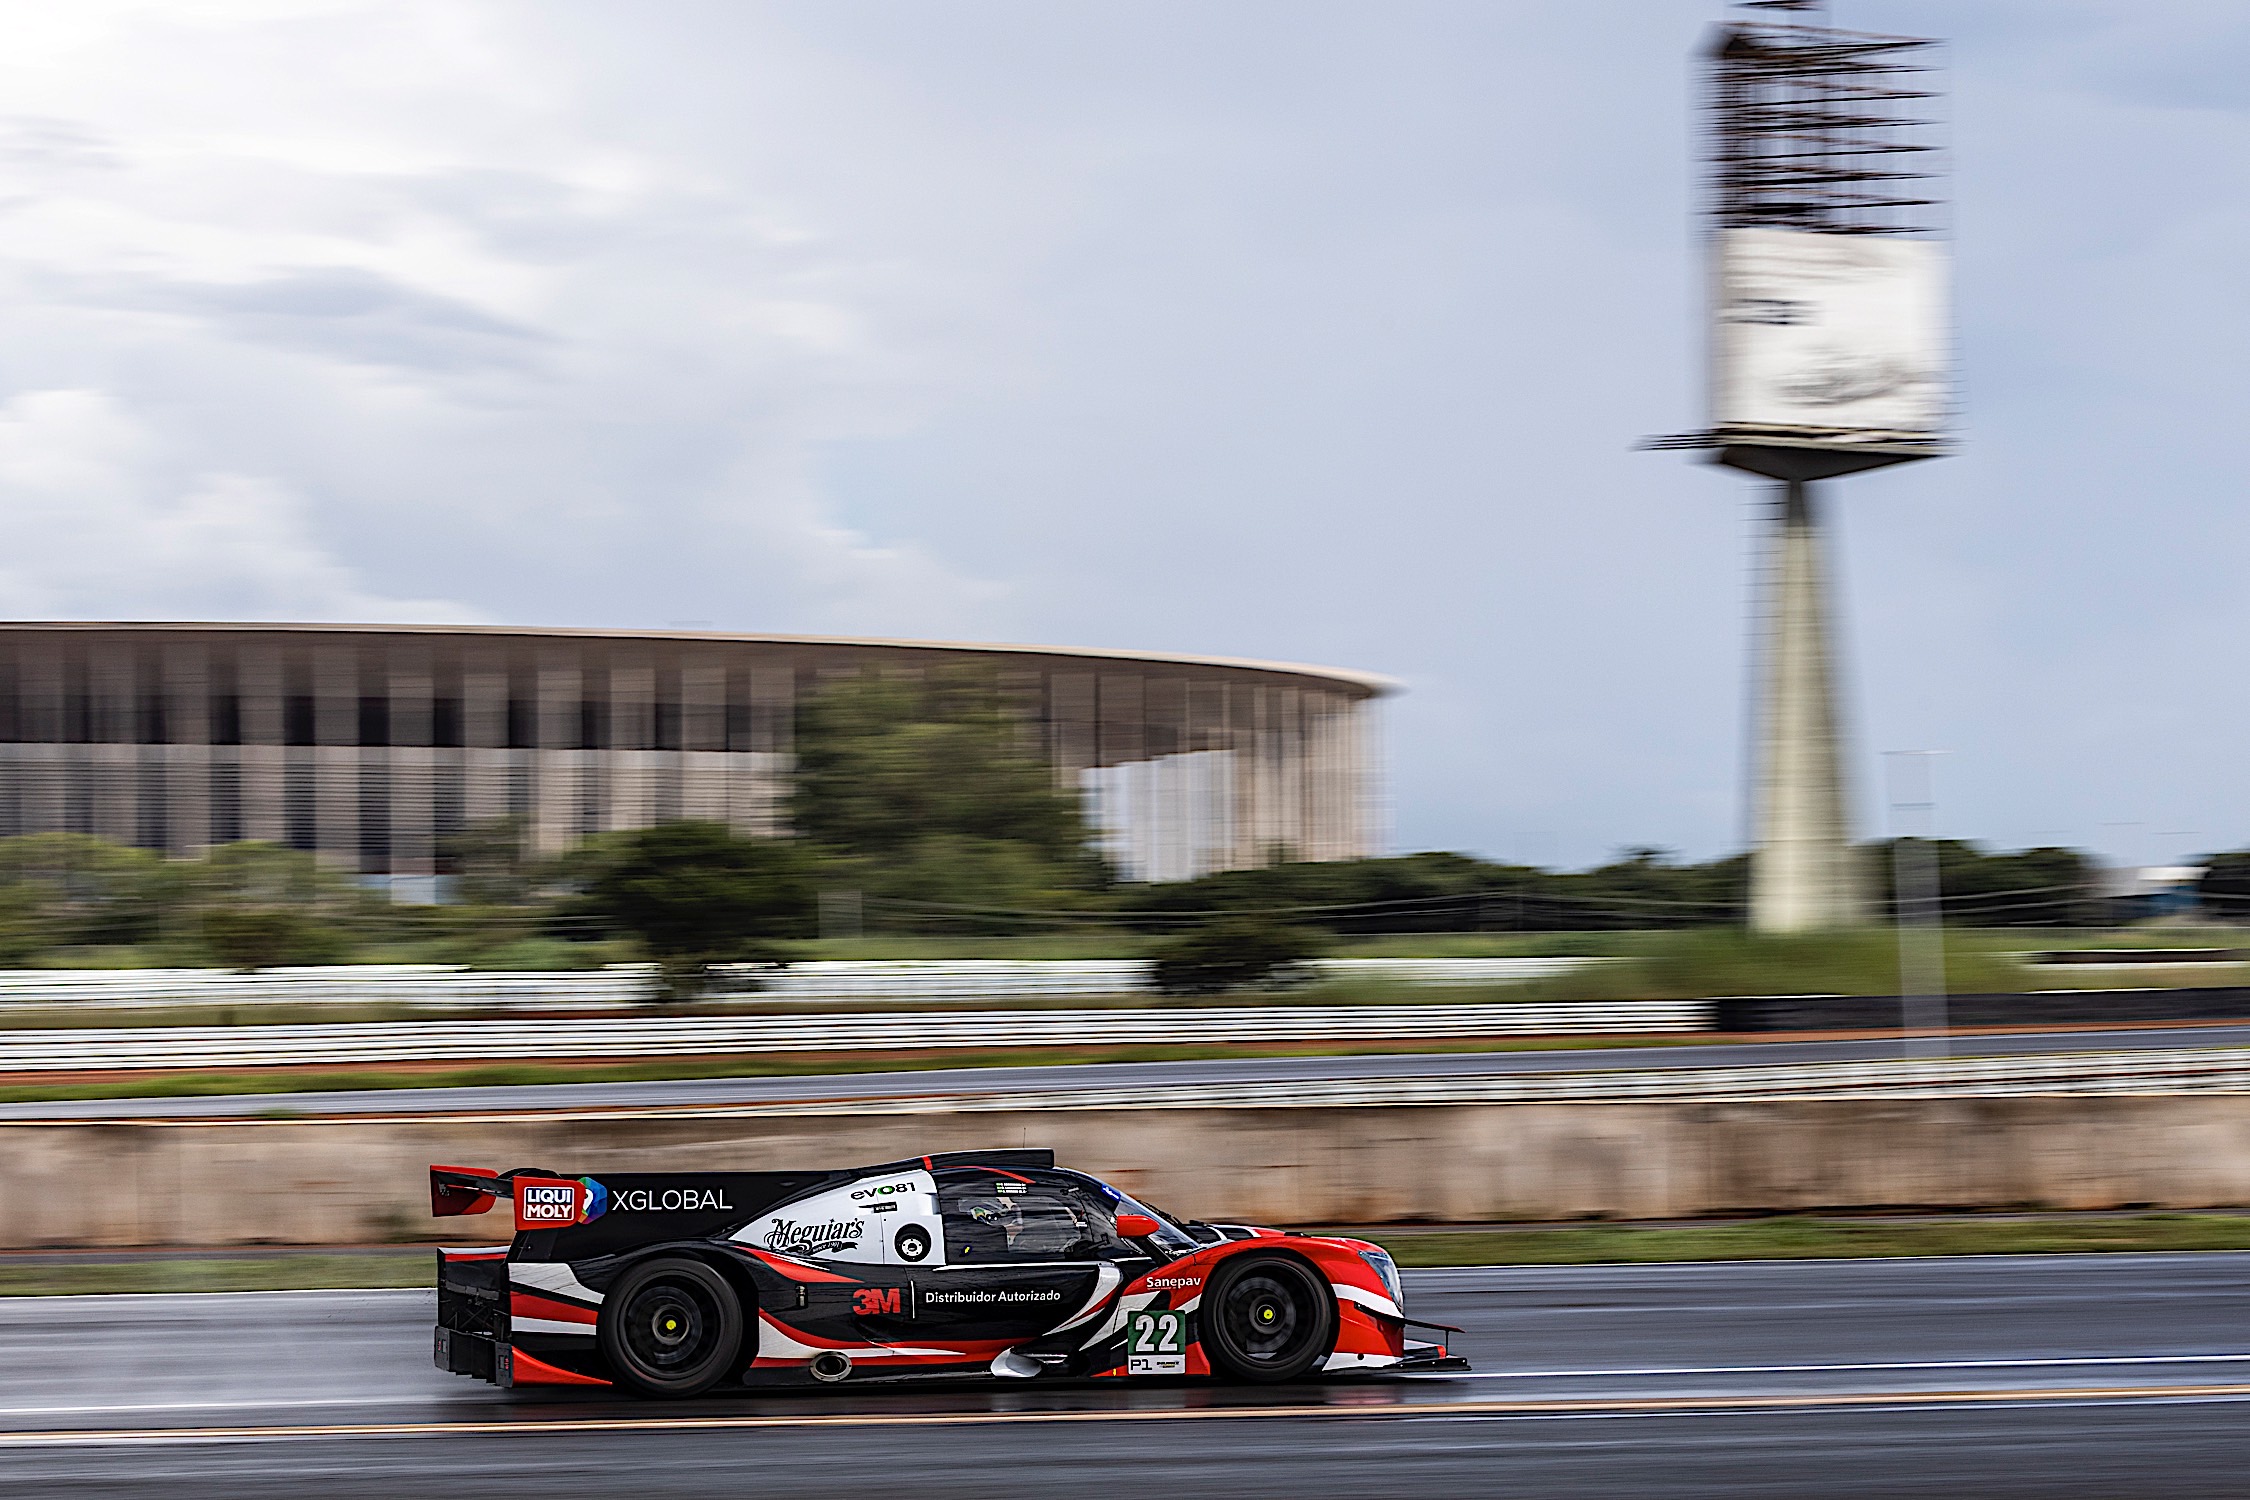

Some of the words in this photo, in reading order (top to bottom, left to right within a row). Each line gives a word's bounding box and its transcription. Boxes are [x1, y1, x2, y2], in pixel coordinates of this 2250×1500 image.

[527, 1189, 571, 1204] LIQUI
[612, 1189, 733, 1211] XGLOBAL
[851, 1182, 916, 1200] evo81
[527, 1204, 572, 1219] MOLY
[764, 1218, 865, 1253] Meguiar's
[1146, 1276, 1201, 1289] Sanepav
[852, 1288, 901, 1316] 3M
[925, 1291, 997, 1303] Distribuidor
[998, 1290, 1061, 1302] Autorizado
[1135, 1314, 1178, 1352] 22
[1130, 1359, 1153, 1370] P1
